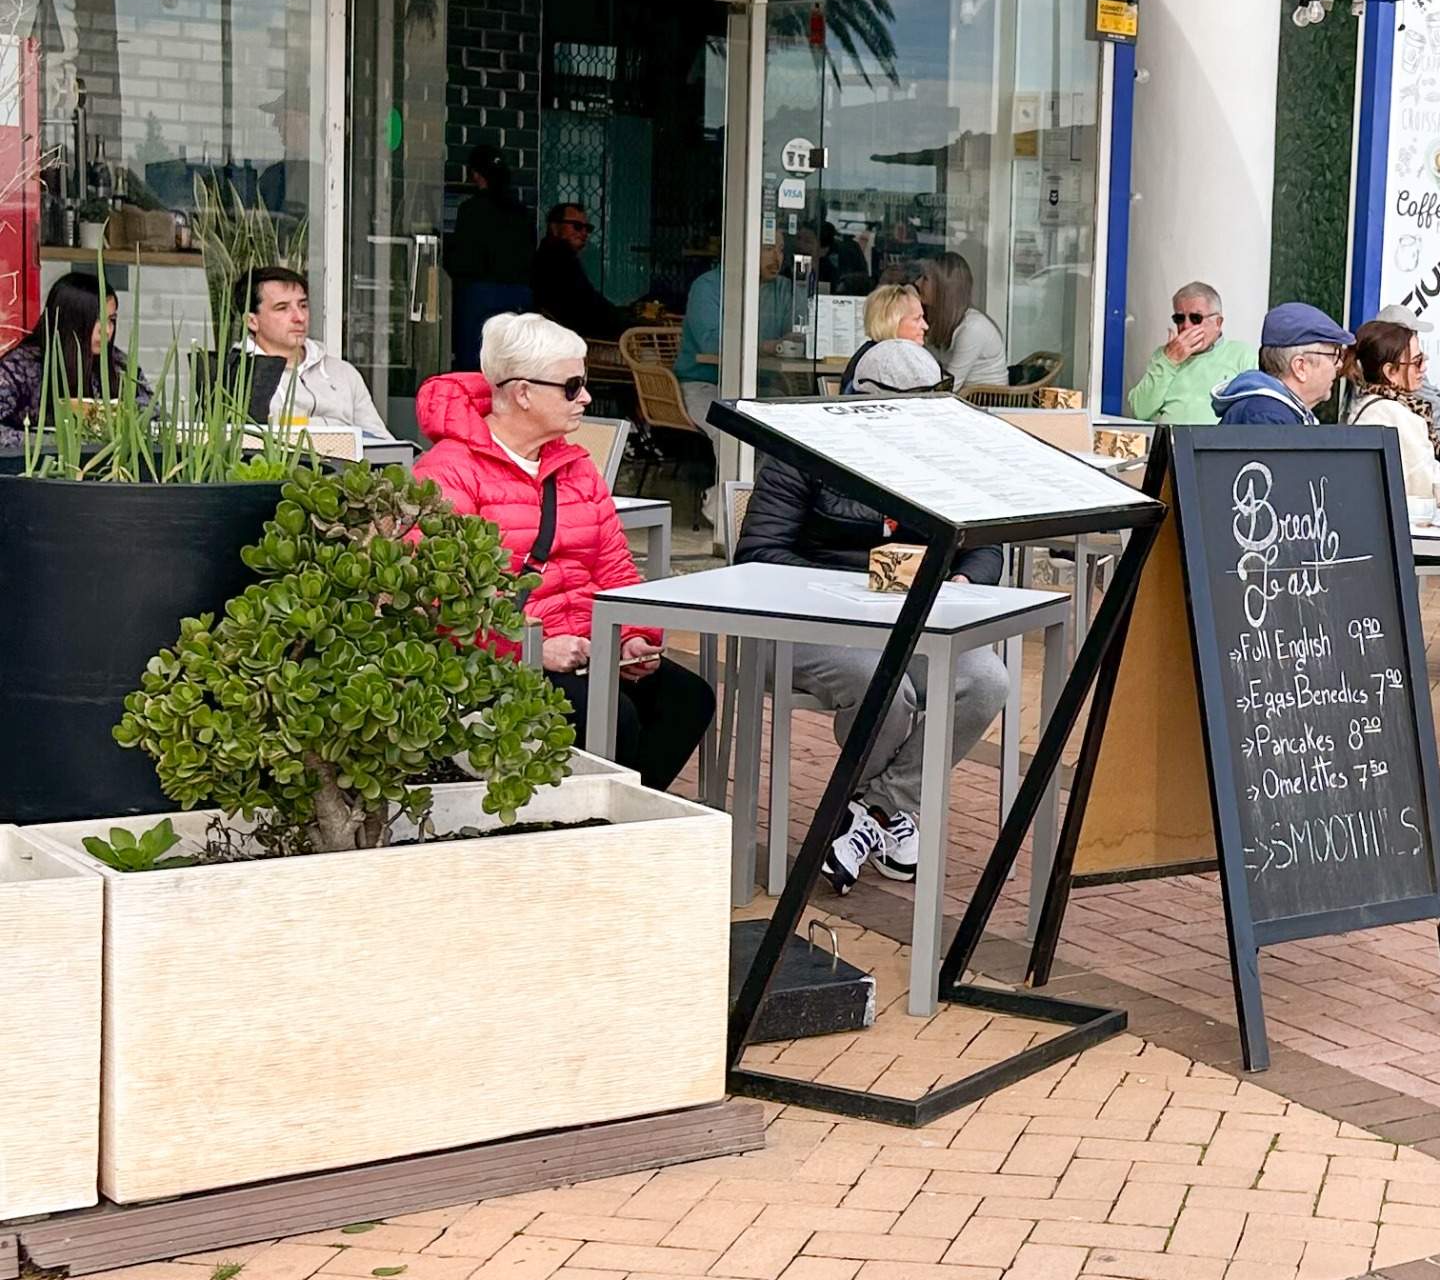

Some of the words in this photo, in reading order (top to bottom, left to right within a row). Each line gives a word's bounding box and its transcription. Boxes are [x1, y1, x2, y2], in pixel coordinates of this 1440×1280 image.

[783, 189, 802, 199] VISA
[1240, 629, 1271, 661] Full
[1275, 624, 1331, 671] English
[1250, 680, 1296, 719] Eggs
[1255, 722, 1334, 757] Pancakes
[1263, 755, 1348, 799] Omelettes
